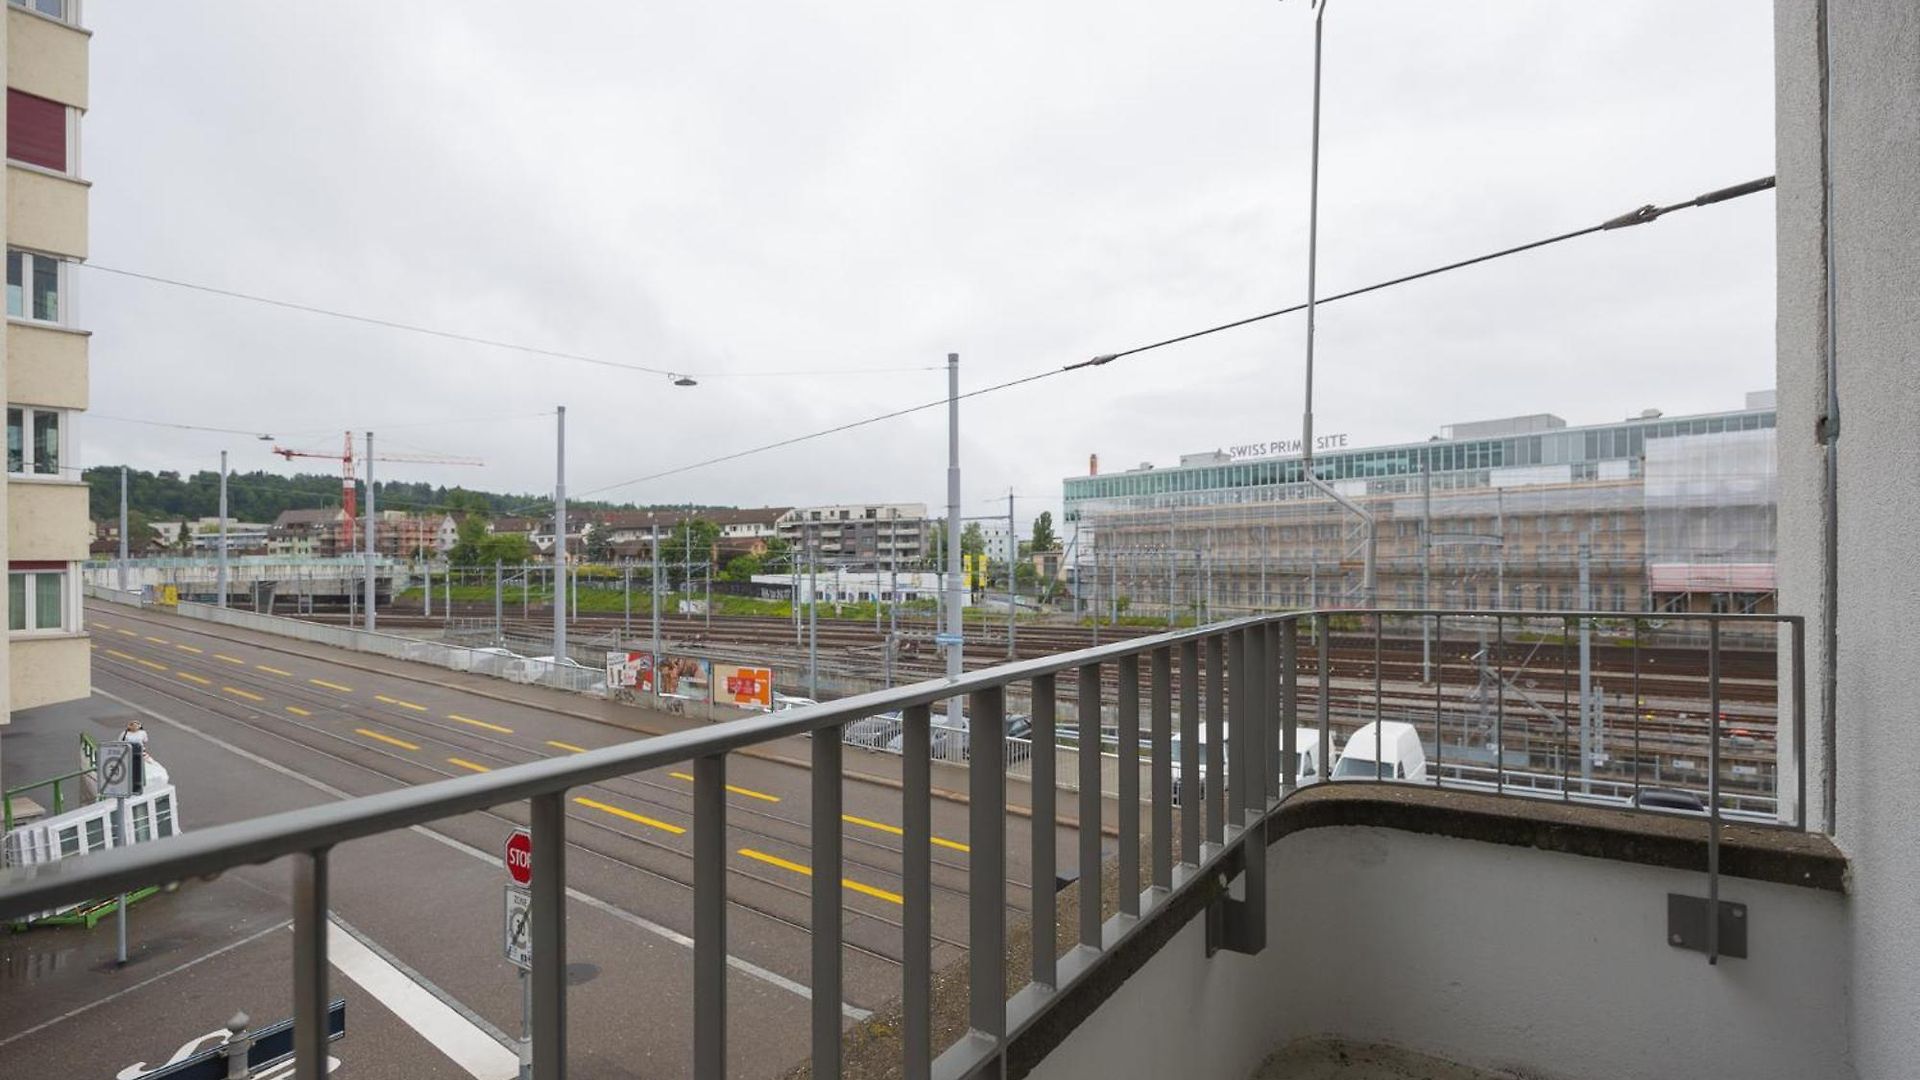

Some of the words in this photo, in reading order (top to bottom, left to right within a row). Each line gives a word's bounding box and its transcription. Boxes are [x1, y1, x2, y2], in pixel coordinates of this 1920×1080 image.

[1230, 443, 1266, 458] SWISS
[1270, 440, 1303, 454] PRIM
[1317, 434, 1348, 449] SITE
